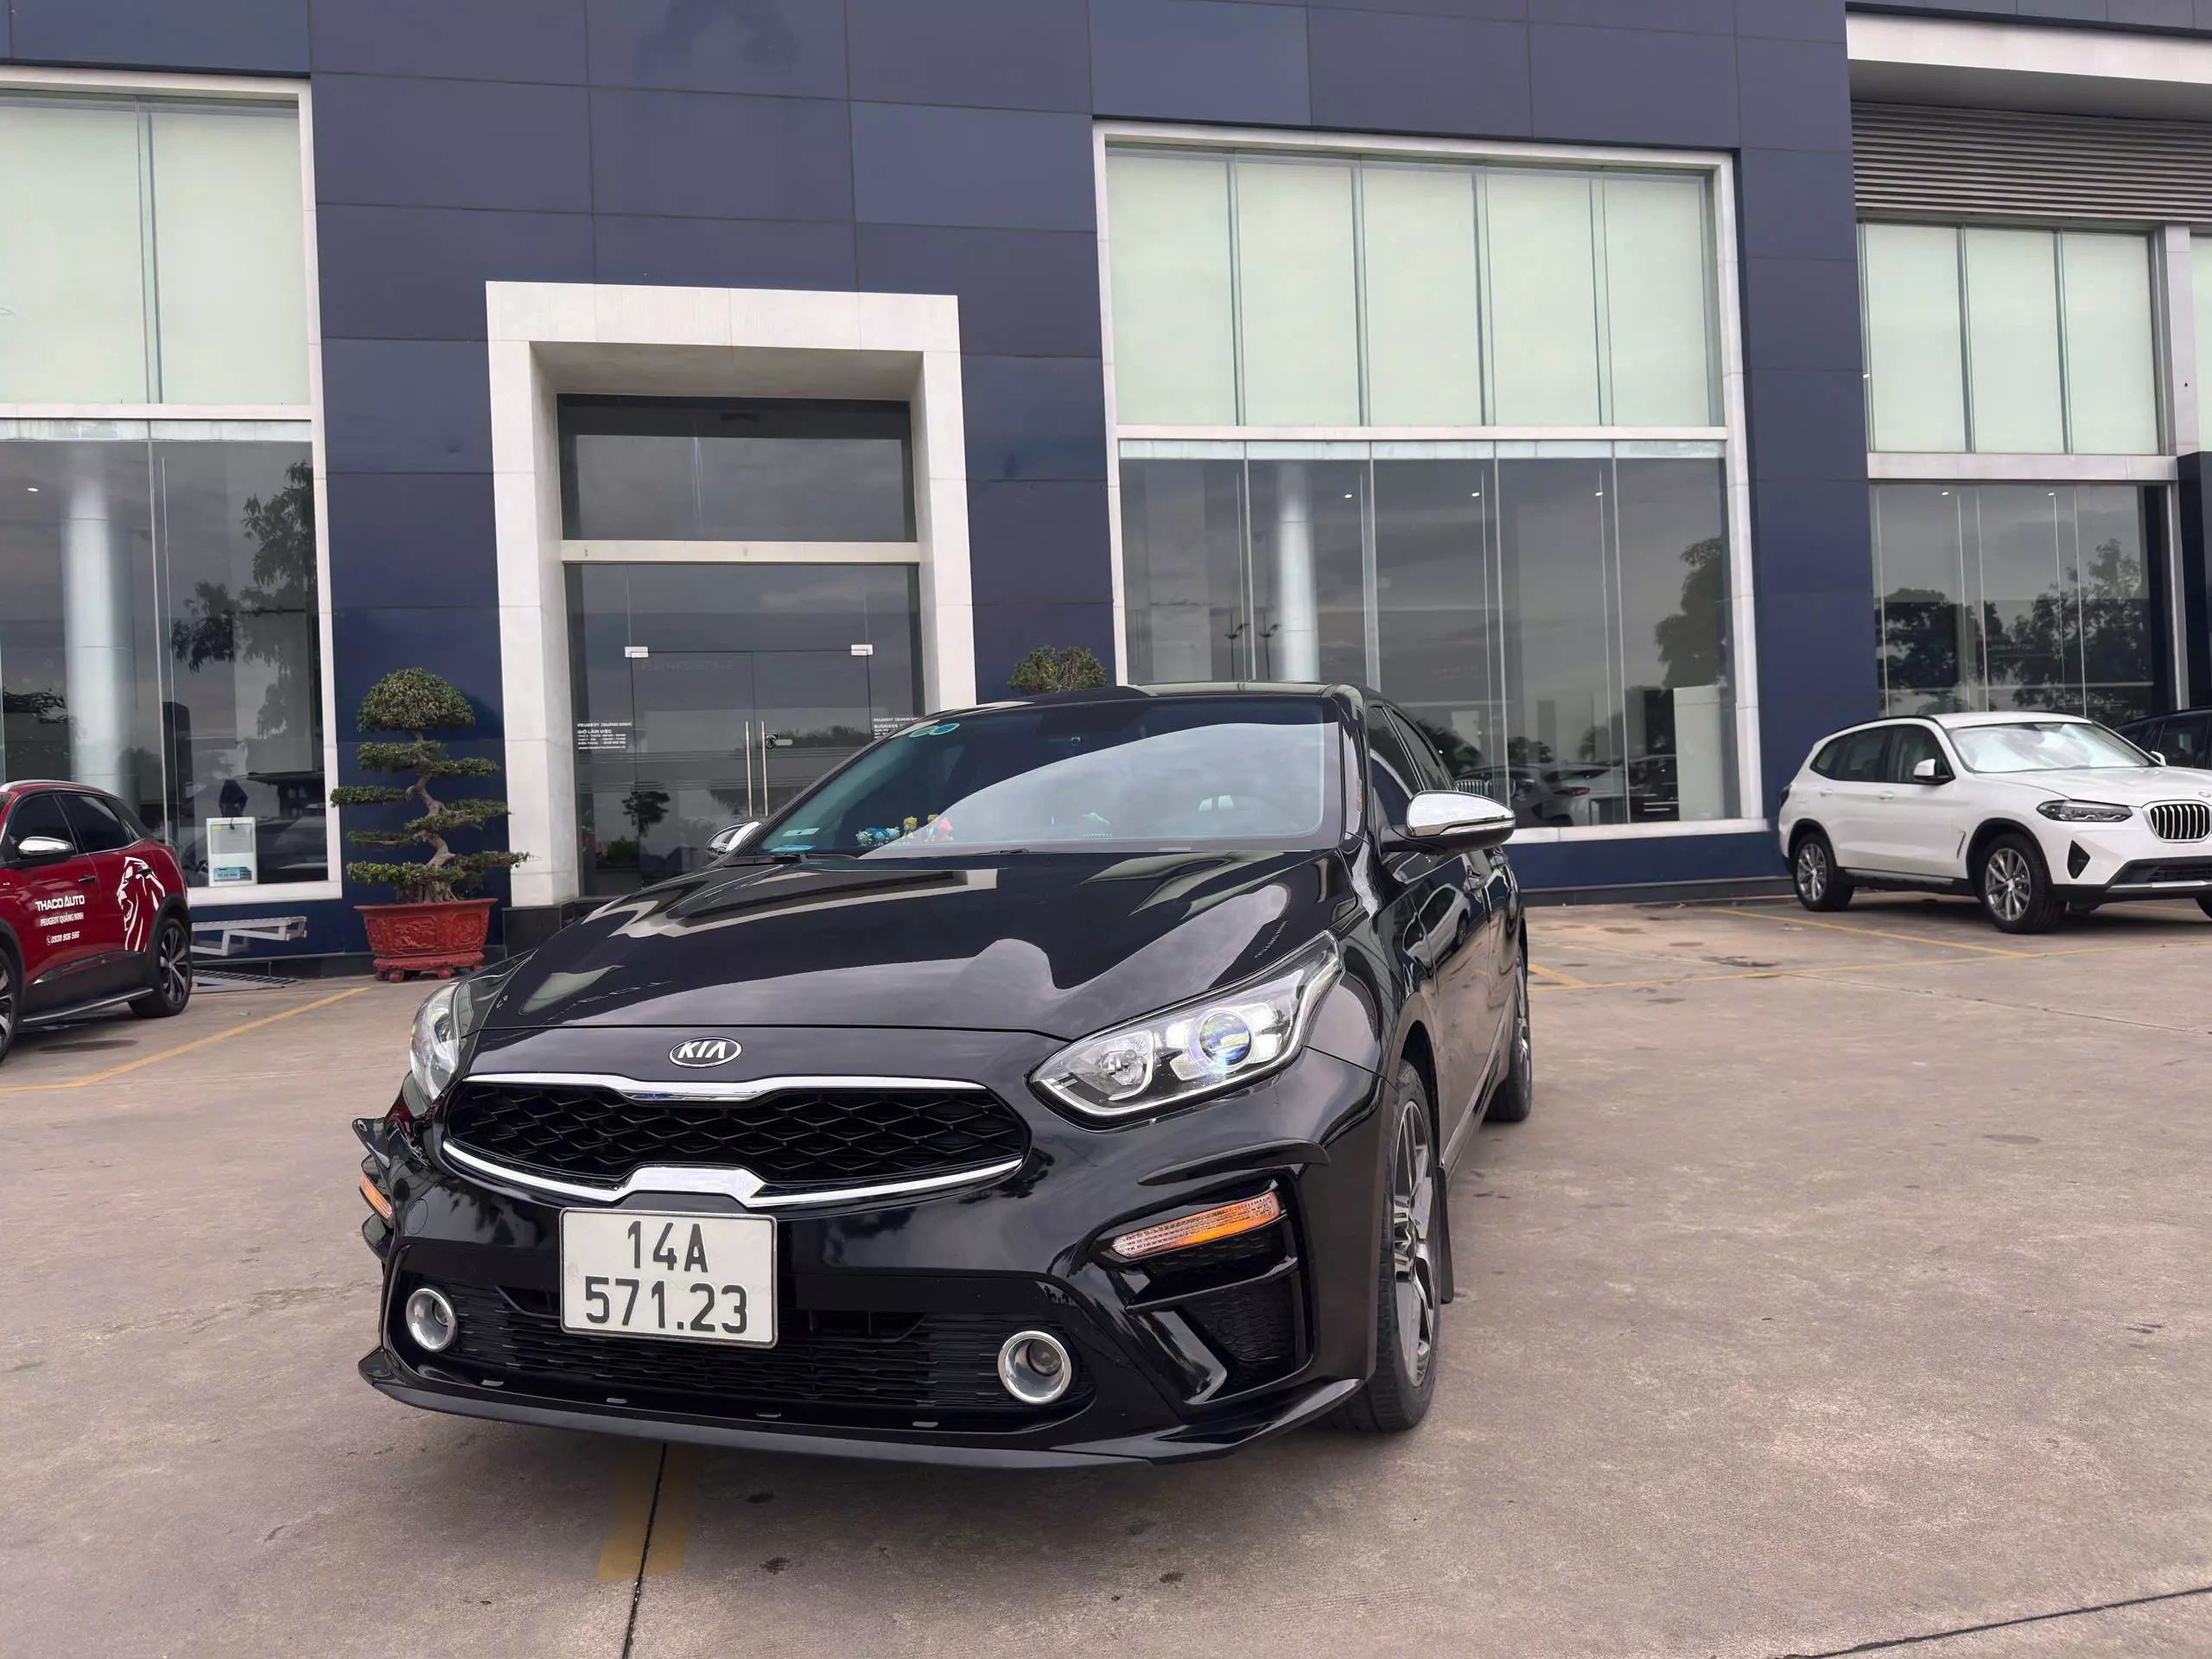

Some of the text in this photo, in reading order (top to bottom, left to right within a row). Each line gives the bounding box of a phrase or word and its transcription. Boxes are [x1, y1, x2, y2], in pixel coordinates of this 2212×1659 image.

[35, 895, 85, 911] THACO AUTO
[40, 916, 59, 927] PEUGEOT
[677, 1040, 727, 1059] KIA
[627, 1220, 709, 1273] 14A
[585, 1275, 747, 1334] 571.23
